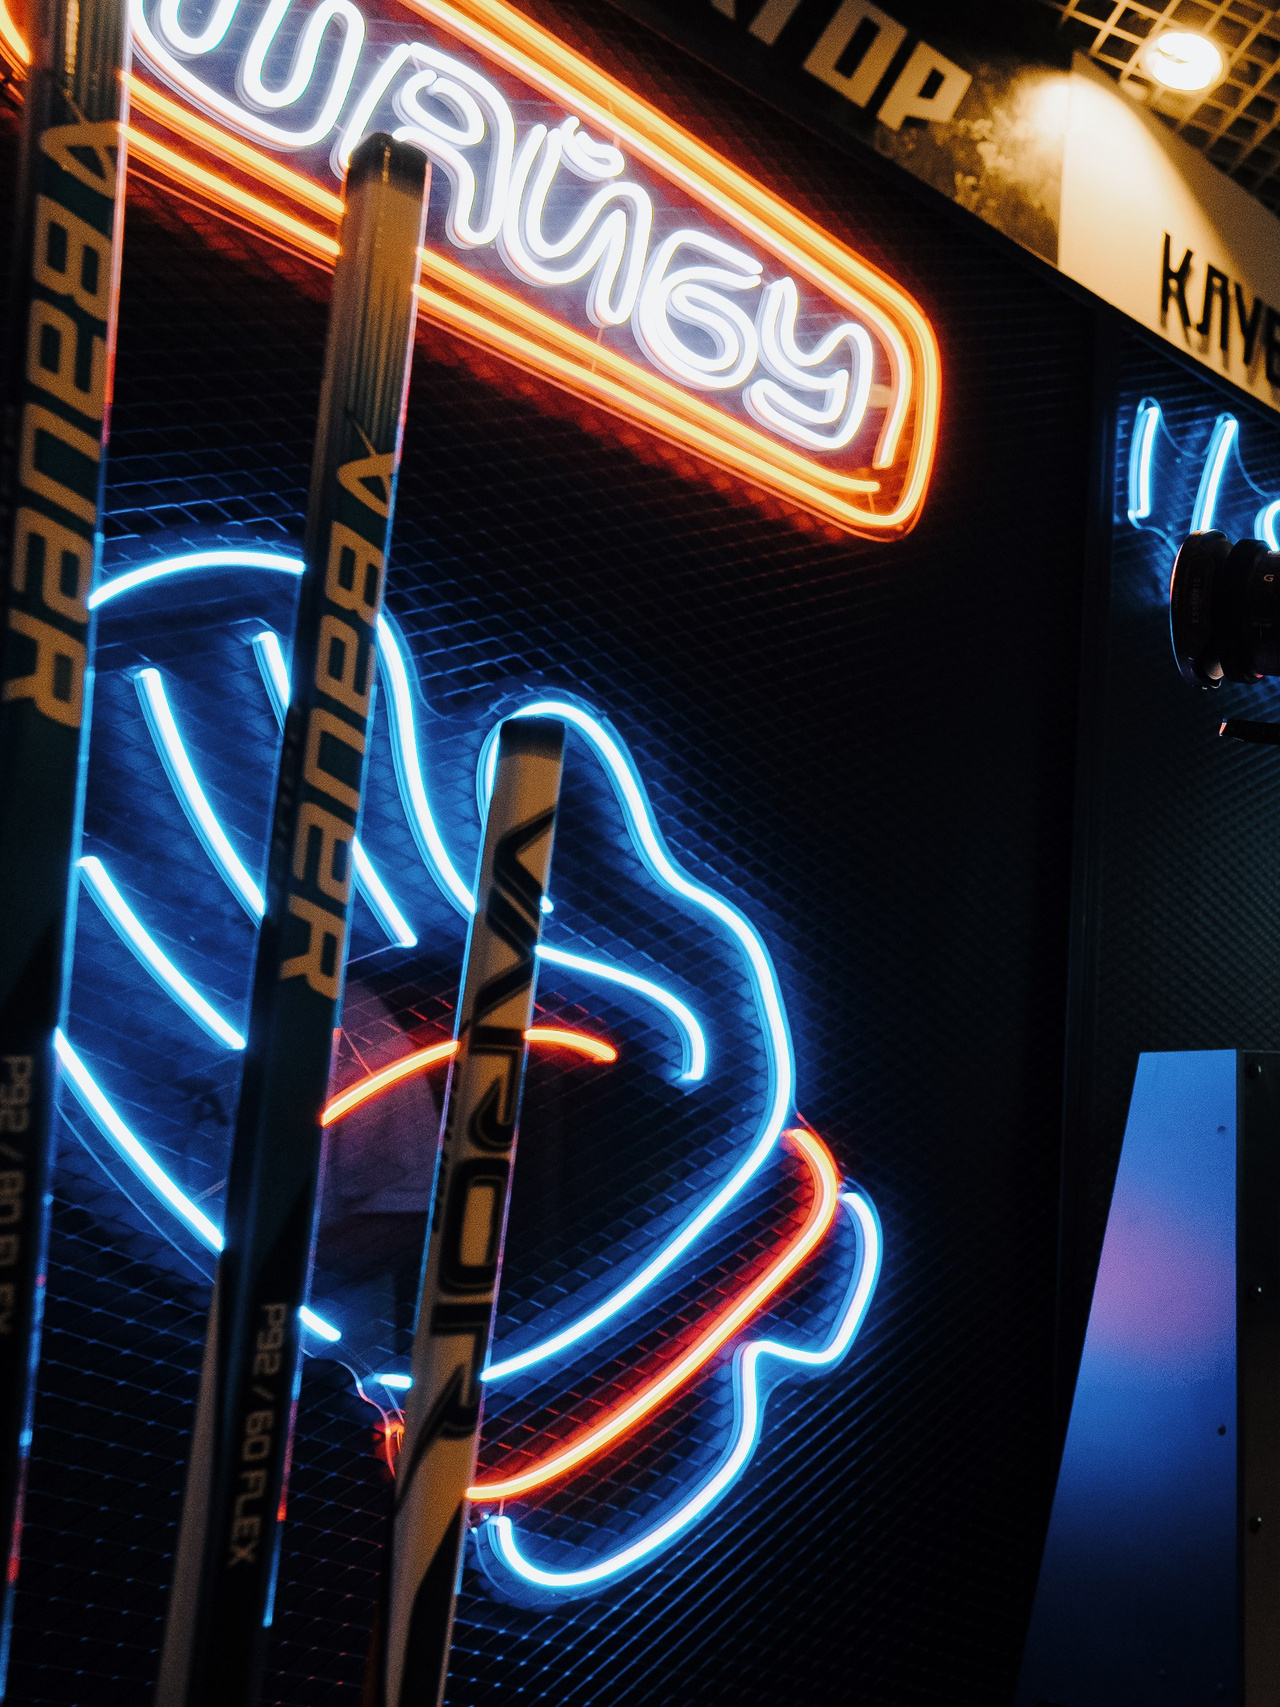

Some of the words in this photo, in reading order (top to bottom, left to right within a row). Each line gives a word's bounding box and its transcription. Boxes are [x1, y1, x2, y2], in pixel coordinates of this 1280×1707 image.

[279, 521, 388, 999] BAUER
[252, 1302, 288, 1377] P92
[240, 1408, 276, 1461] 60
[225, 1467, 269, 1570] FLEX
